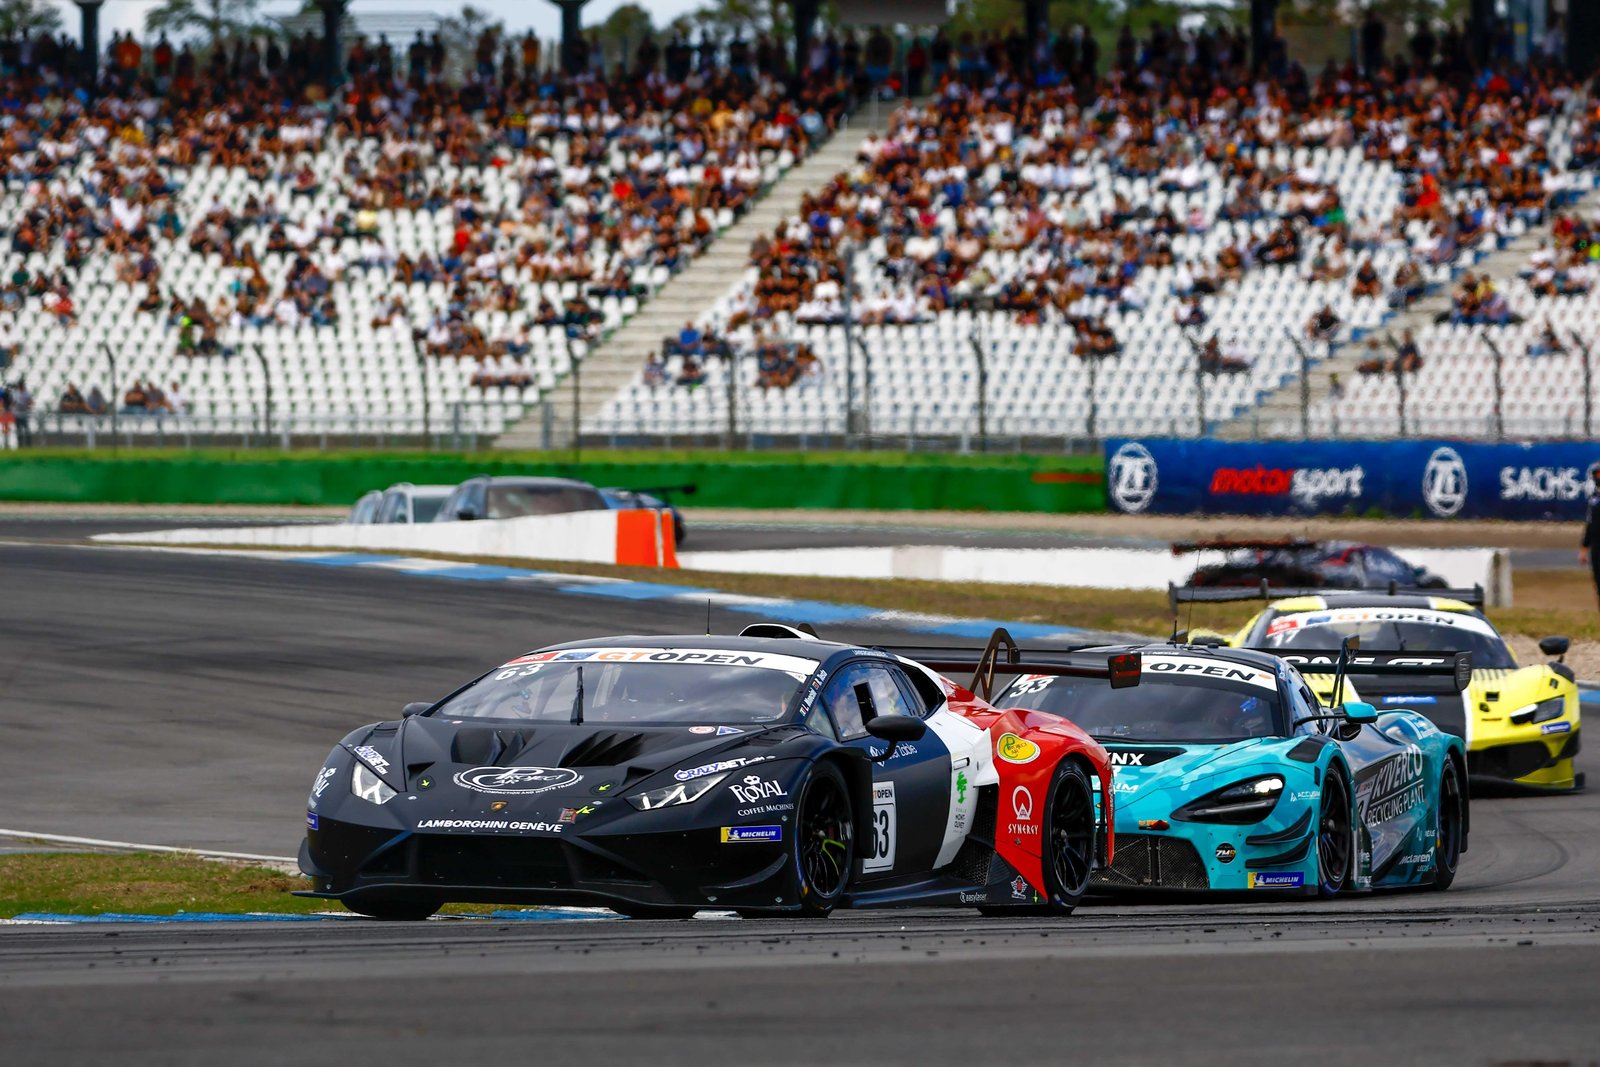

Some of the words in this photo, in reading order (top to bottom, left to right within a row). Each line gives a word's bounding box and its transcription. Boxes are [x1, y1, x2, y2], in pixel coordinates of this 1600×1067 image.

[494, 663, 545, 681] 63
[1148, 661, 1256, 682] OPEN
[1009, 678, 1054, 698] 33
[1372, 743, 1423, 800] KIVERCO
[728, 779, 788, 804] ROYAL
[737, 805, 765, 817] COFFEE
[766, 802, 794, 812] MACHINES
[1367, 795, 1403, 829] RECYCLING
[1403, 784, 1425, 810] PLANT
[417, 819, 508, 830] LAMBORGHINI
[509, 820, 564, 833] GENÈVE
[741, 829, 777, 838] MICHELIN
[1007, 823, 1039, 835] SYNERGY
[1398, 853, 1432, 865] McLaren
[1265, 876, 1300, 884] MICHELIN
